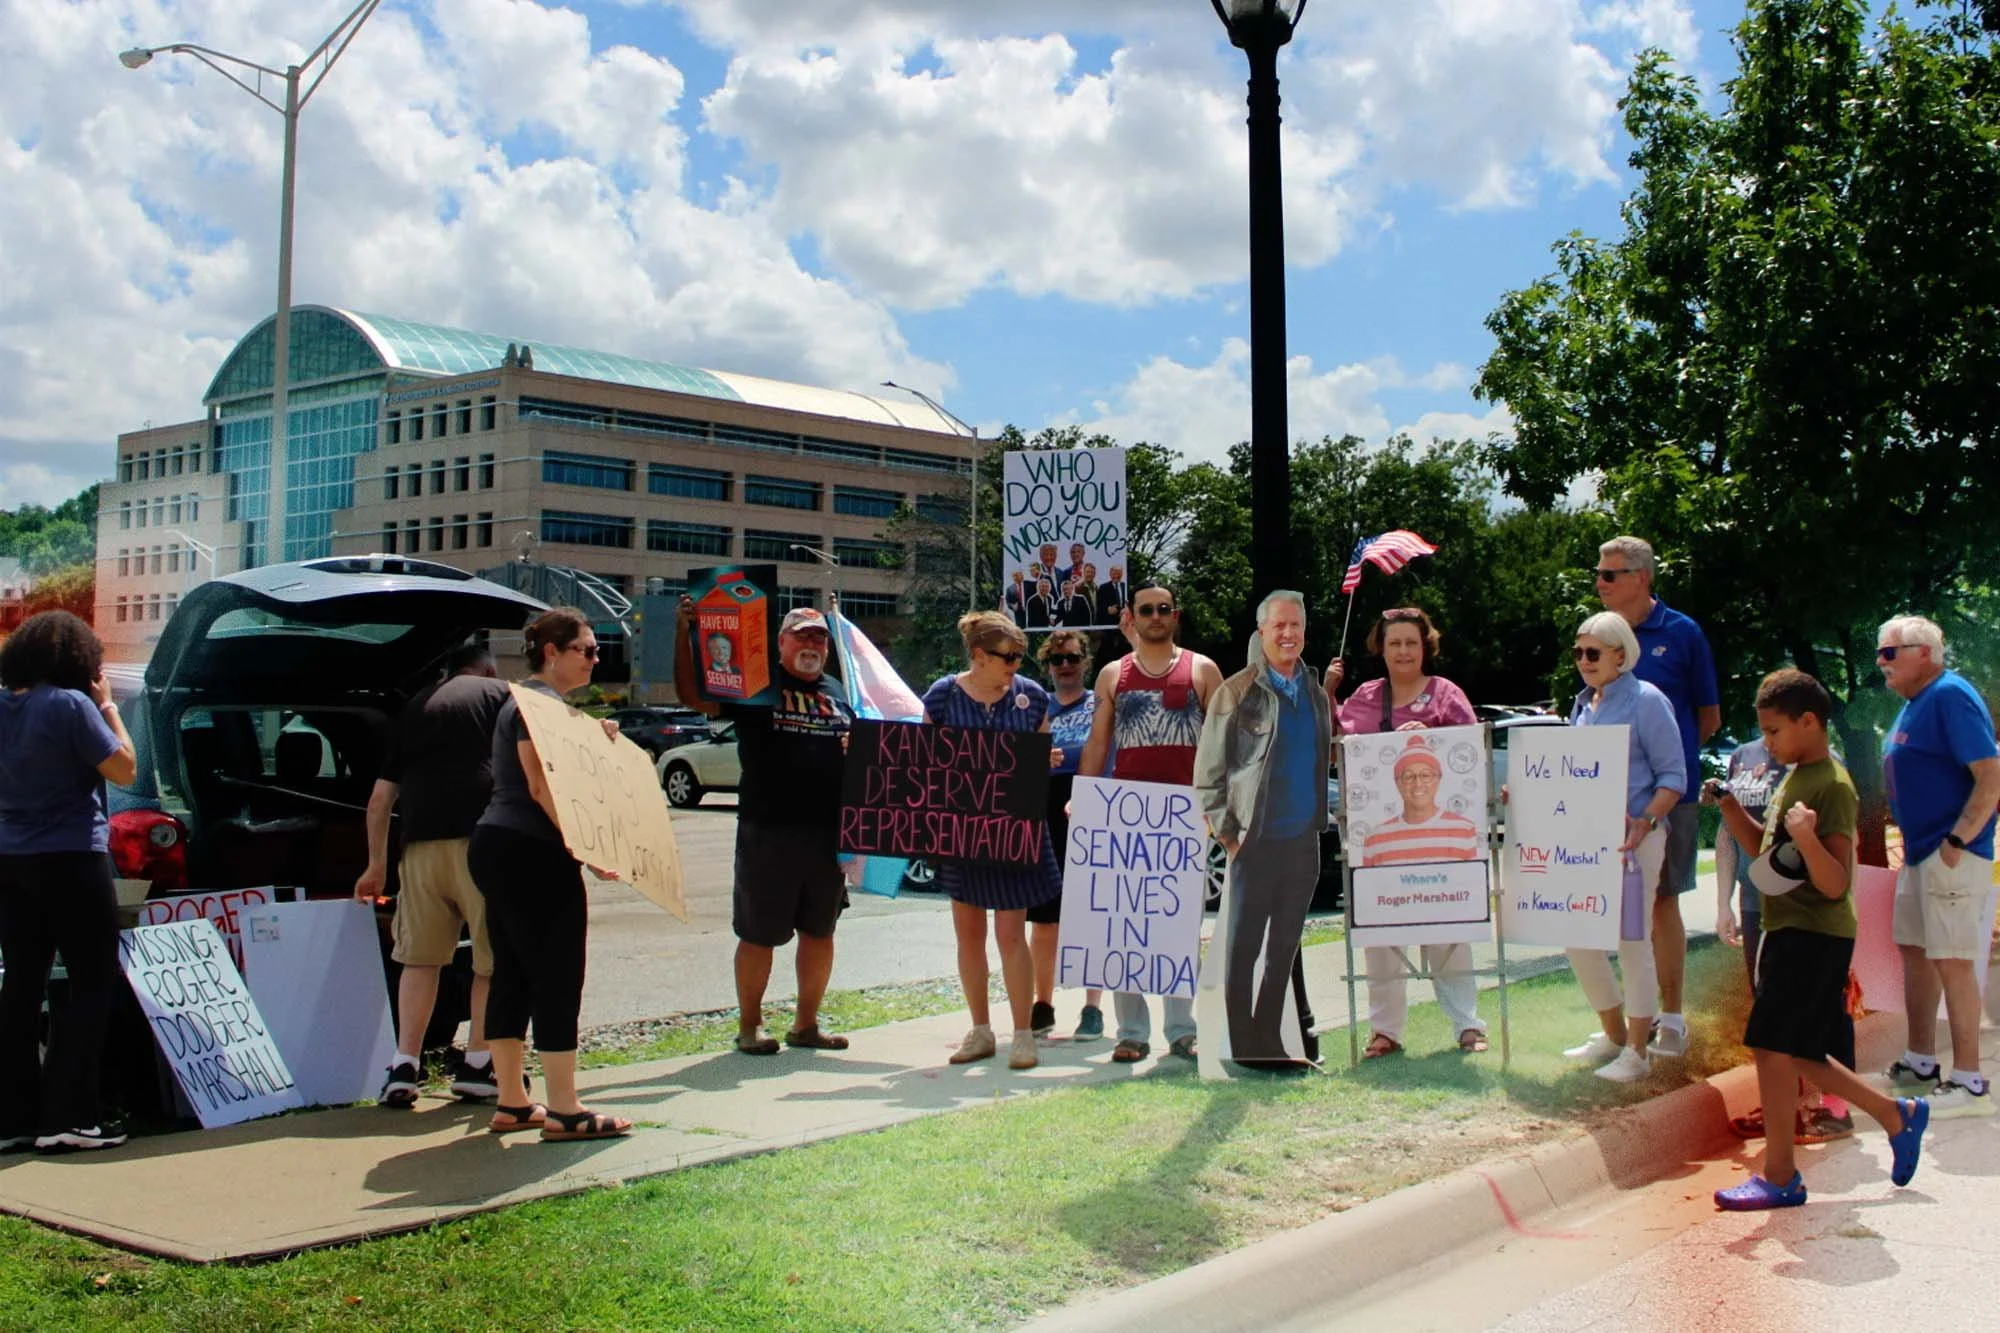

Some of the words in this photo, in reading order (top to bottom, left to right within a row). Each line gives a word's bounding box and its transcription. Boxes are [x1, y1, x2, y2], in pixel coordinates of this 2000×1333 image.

[1021, 451, 1095, 484] WHO
[1006, 482, 1053, 516] DO
[1060, 480, 1120, 515] YOU
[1003, 515, 1070, 563] WORK
[1072, 514, 1126, 558] FOR?
[700, 615, 722, 630] HAVE
[722, 615, 739, 630] YOU
[707, 671, 728, 687] SEEN
[728, 673, 742, 689] ME?
[878, 722, 1017, 774] KANSANS
[1524, 754, 1551, 779] We
[1561, 754, 1600, 779] Need
[864, 766, 1013, 815] DESERVE
[1094, 783, 1196, 831] YOUR
[1553, 800, 1567, 816] A
[840, 806, 1044, 865] REPRESENTATION
[1070, 825, 1204, 873] SENATOR
[1090, 872, 1180, 917] LIVES
[1377, 895, 1411, 907] Roger
[1412, 890, 1470, 904] Marshall?
[1400, 872, 1448, 885] Where's
[1517, 896, 1529, 911] in
[118, 924, 219, 969] MISSING:
[1106, 917, 1149, 948] IN
[143, 961, 237, 1009] ROGER
[1060, 945, 1196, 997] FLORIDA
[175, 1045, 295, 1113] MARSHALL
